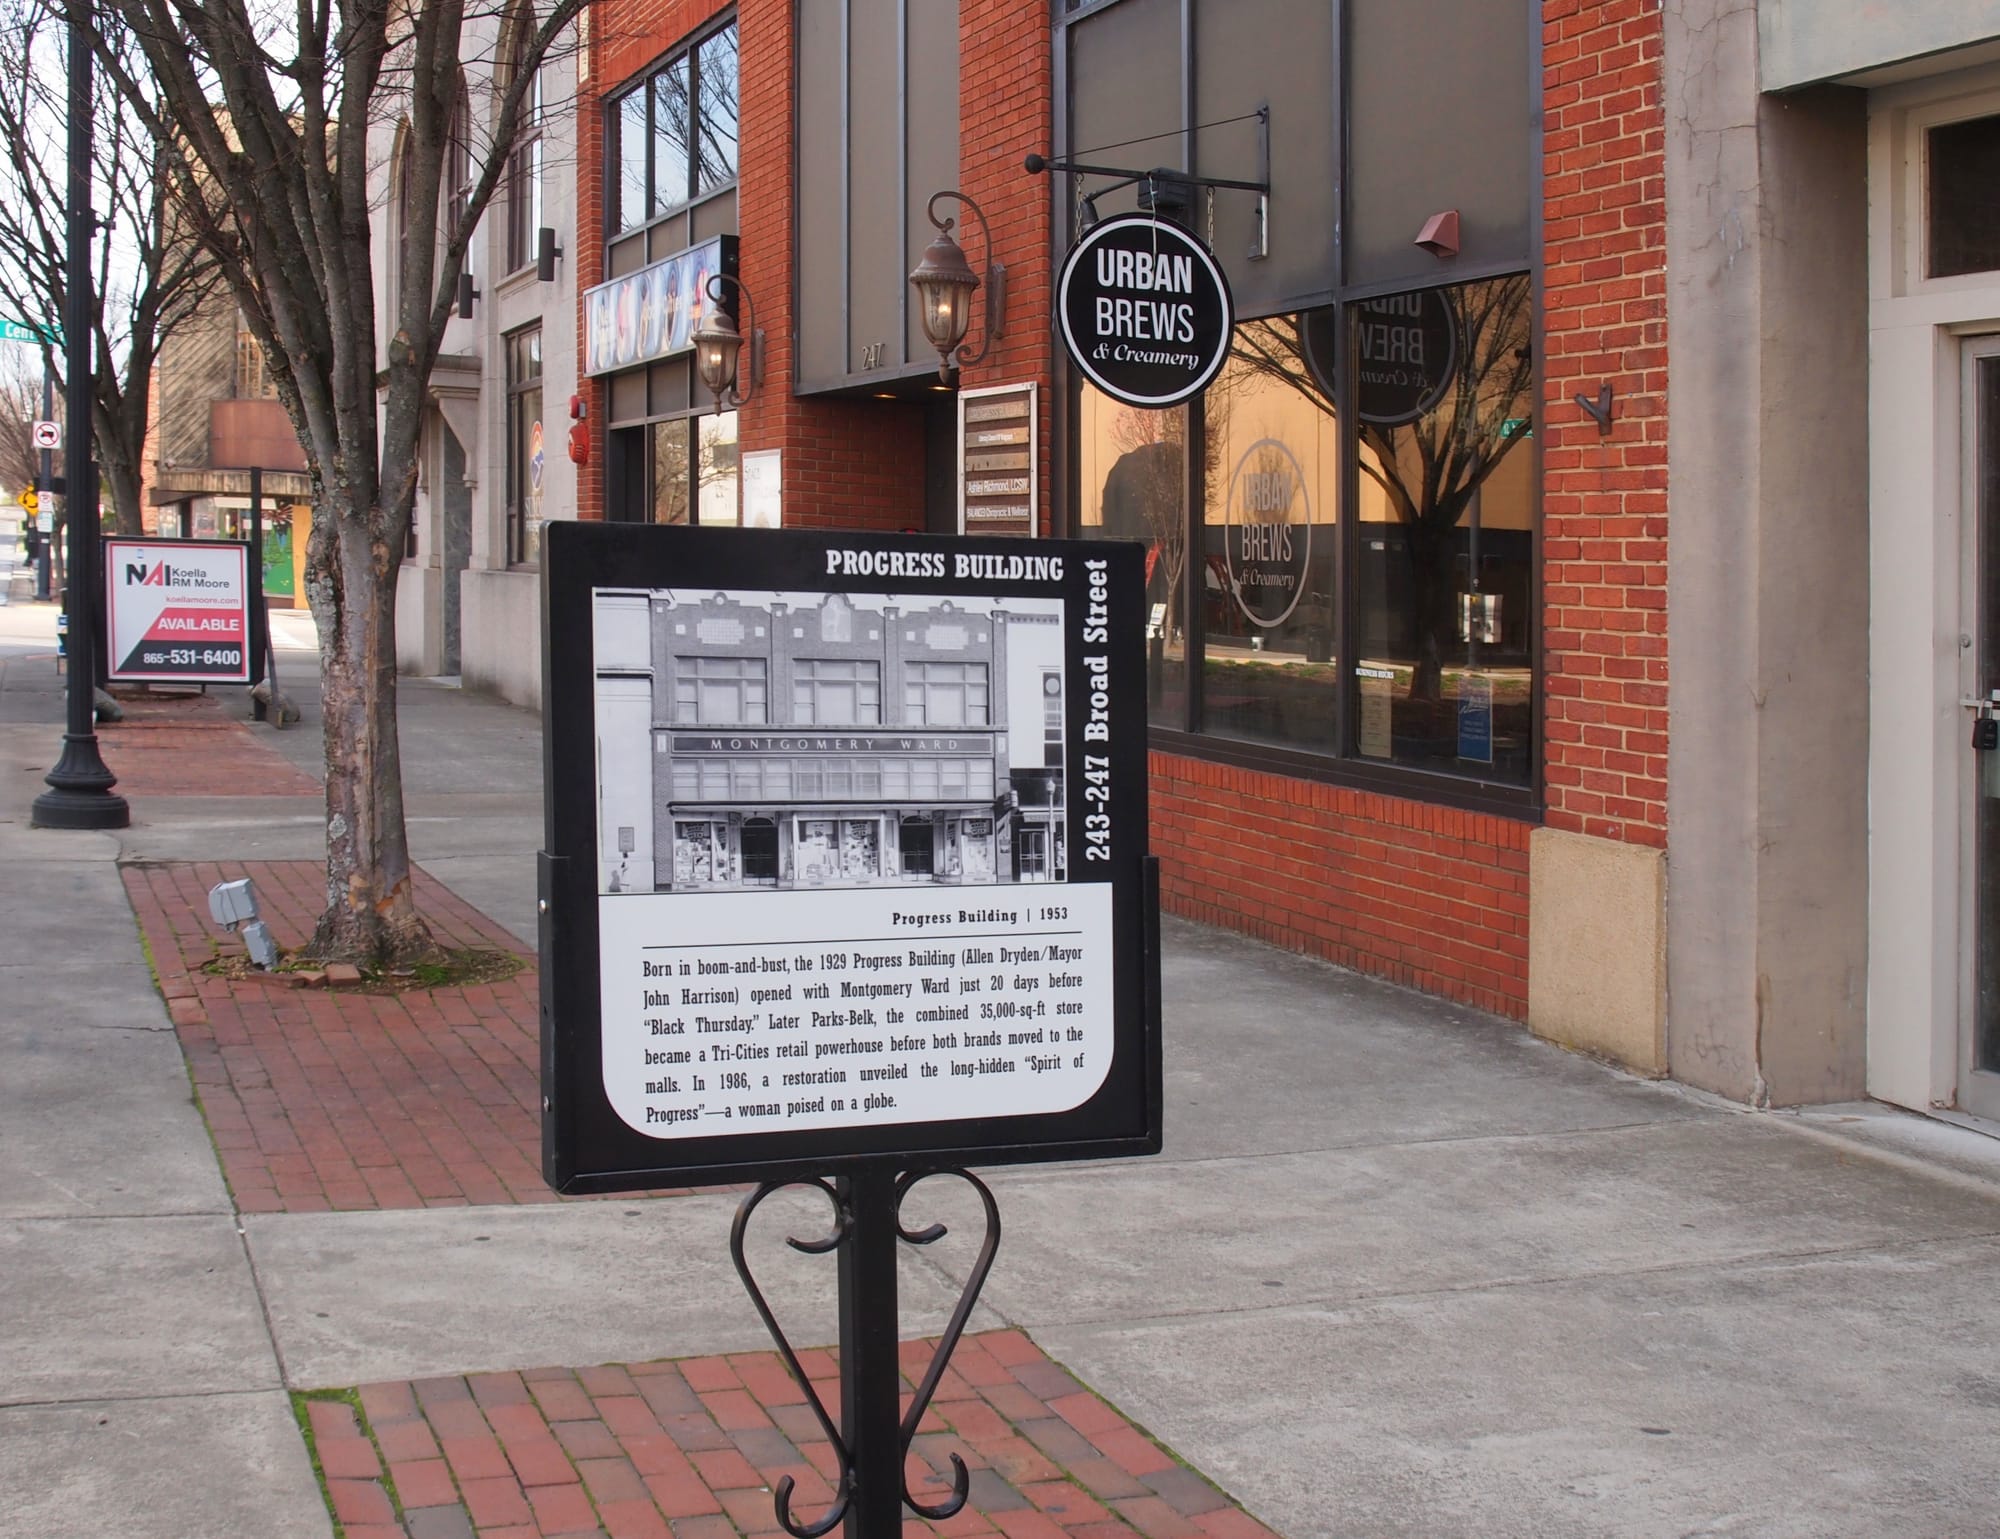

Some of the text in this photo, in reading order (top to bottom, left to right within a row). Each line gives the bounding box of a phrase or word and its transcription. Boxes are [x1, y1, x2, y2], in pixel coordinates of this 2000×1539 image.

[1097, 248, 1193, 294] URBAN
[1096, 296, 1195, 343] BREWS
[862, 342, 882, 370] 247
[1092, 342, 1200, 371] & Creamery
[1243, 472, 1292, 511] URBAN
[1241, 523, 1292, 562] BREWS
[126, 560, 207, 587] NAI Koella
[826, 549, 1065, 582] PROGRESS BUILDING
[1239, 568, 1295, 591] & Creamery
[172, 578, 230, 589] RM Moore
[165, 596, 239, 605] koellamoore.com
[157, 617, 240, 632] AVAILABLE
[143, 649, 241, 665] 865-531-6400
[1083, 559, 1112, 861] 243-247 Broad Street
[711, 738, 958, 750] MONTGOMERY WARD
[892, 912, 952, 928] Progress
[958, 909, 1017, 925] Building
[1040, 906, 1068, 921] 1953
[642, 945, 1083, 977] Born in boom-and-bust, the 1929 Progress Building (Allen Dryden/Mayor
[643, 971, 1083, 1010] John Harrison) opened with Montgomery Ward just 20 days before
[643, 1017, 685, 1036] “Black
[768, 1013, 800, 1030] Later
[811, 1008, 877, 1028] Parks-Belk,
[886, 1007, 904, 1024] the
[915, 1004, 969, 1023] combined
[980, 1000, 1046, 1021] 35,000-sq-ft
[1056, 1001, 1083, 1015] store
[644, 1026, 1083, 1065] became a Tri-Cities retail powerhouse before both brands moved to the
[645, 1052, 1085, 1095] malls. In 1986, a restoration unveiled the long-hidden “Spirit of
[738, 1103, 781, 1117] woman
[787, 1096, 825, 1118] poised
[830, 1099, 845, 1112] on
[850, 1098, 858, 1110] a
[863, 1092, 897, 1113] globe.
